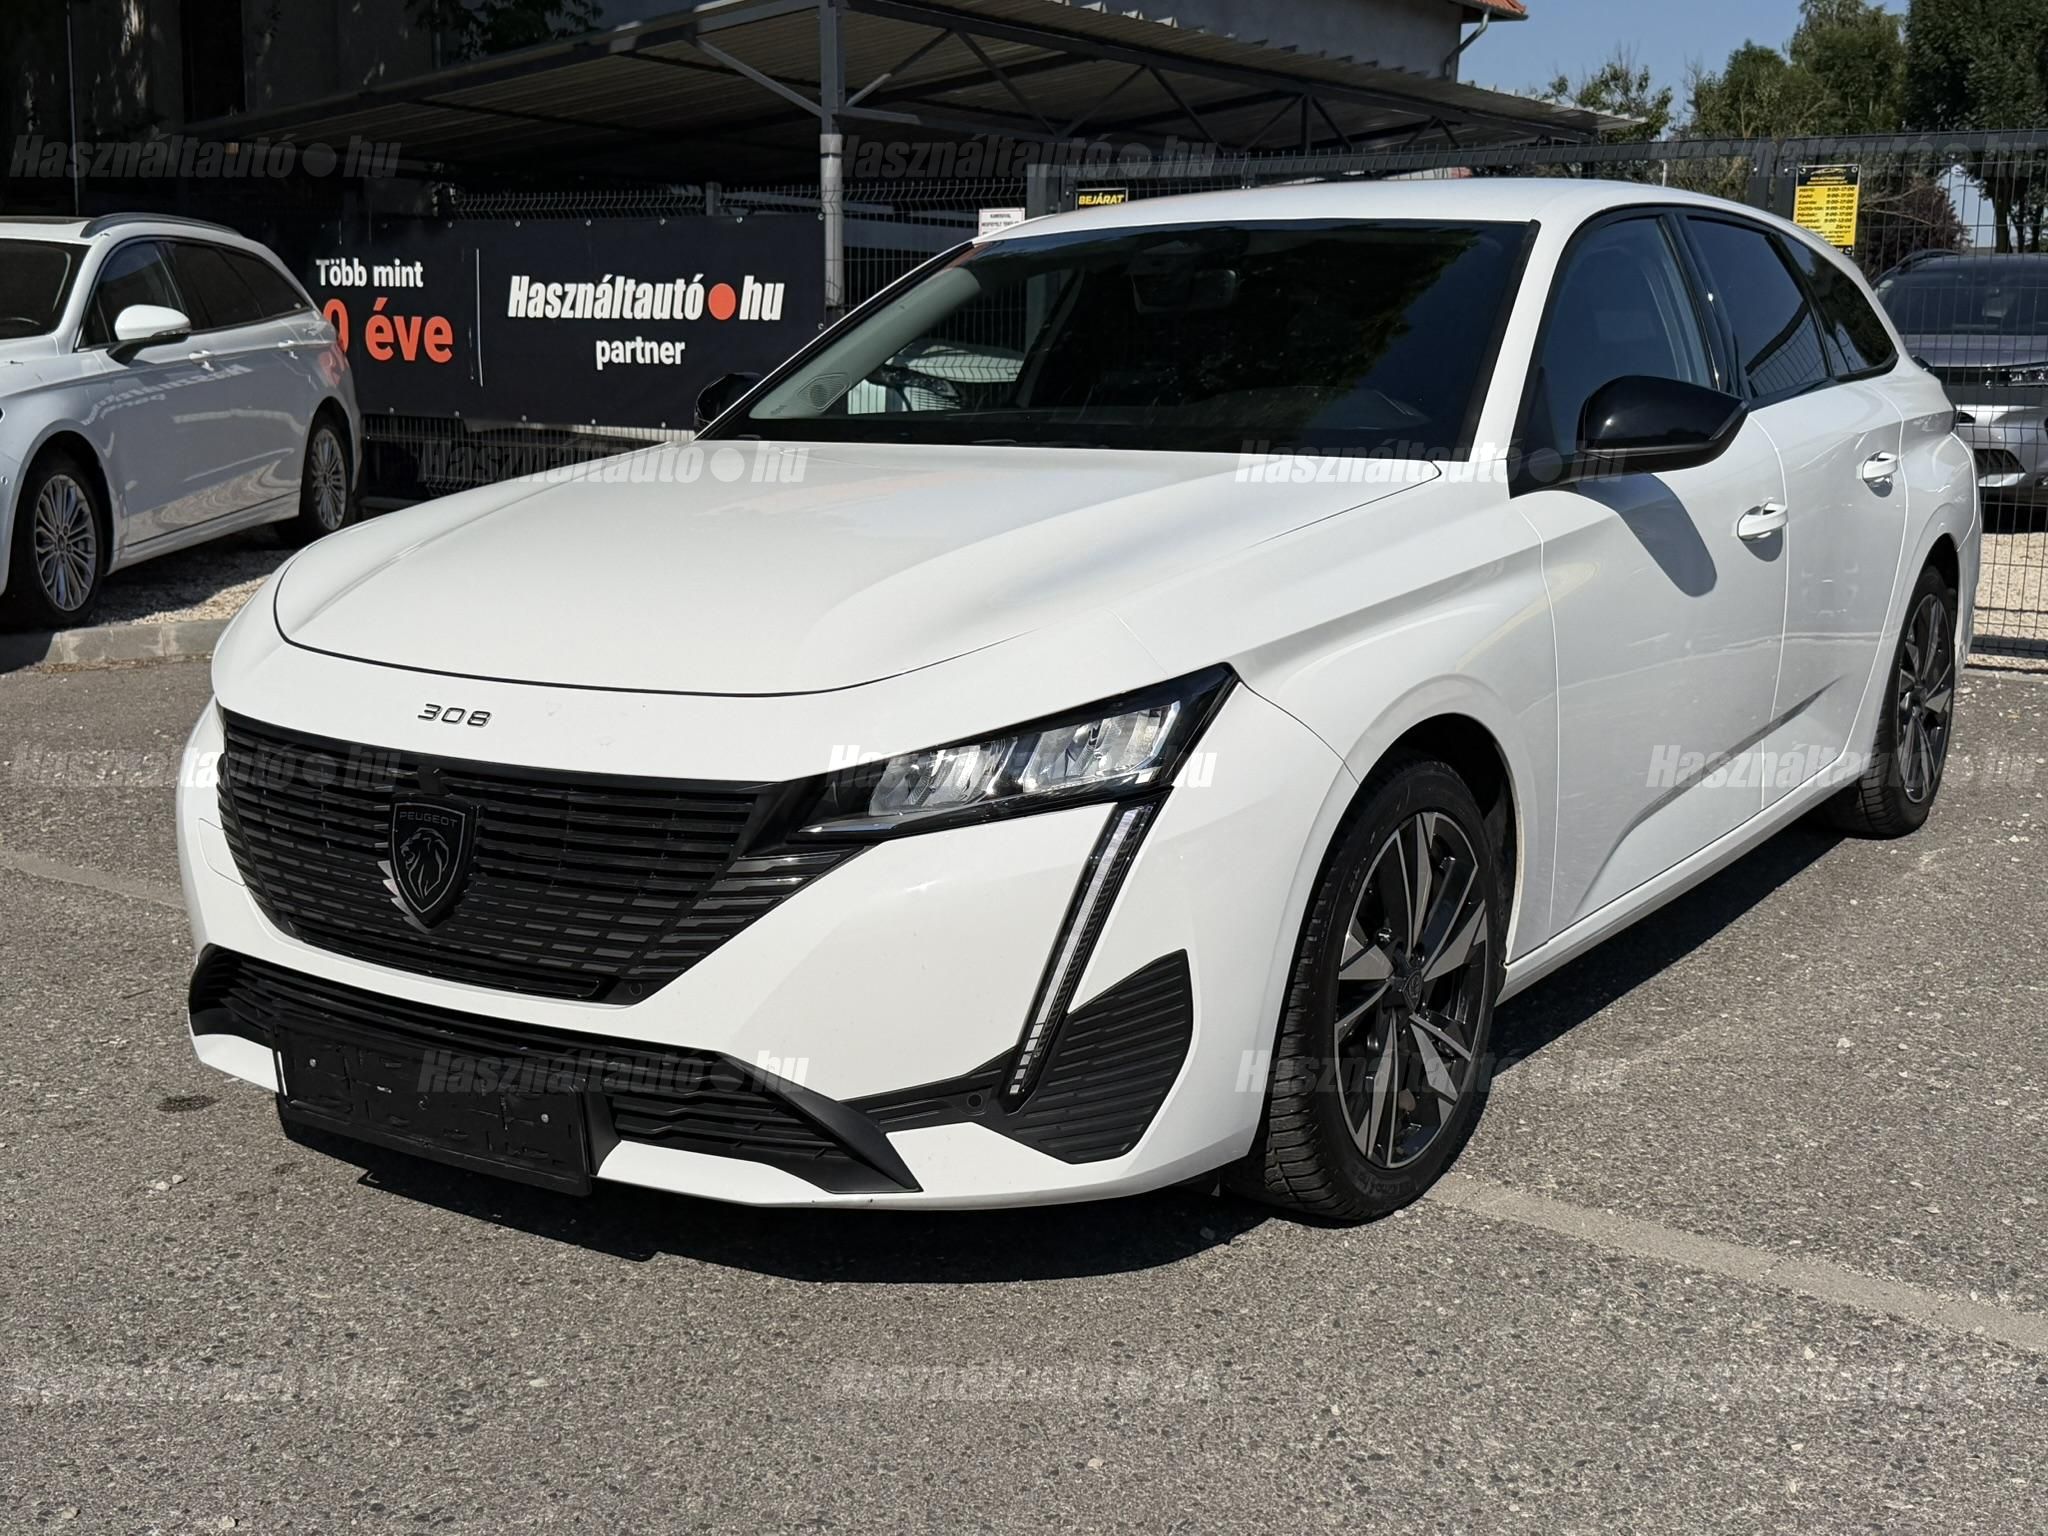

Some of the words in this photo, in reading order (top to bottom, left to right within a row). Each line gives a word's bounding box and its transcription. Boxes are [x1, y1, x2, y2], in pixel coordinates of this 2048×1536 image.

[1078, 192, 1125, 205] BEJÁRAT
[316, 257, 367, 287] Több
[373, 258, 424, 288] mint
[365, 297, 454, 364] éve
[596, 336, 686, 370] partner
[417, 703, 492, 727] 308
[400, 811, 459, 829] PEUGEOT
